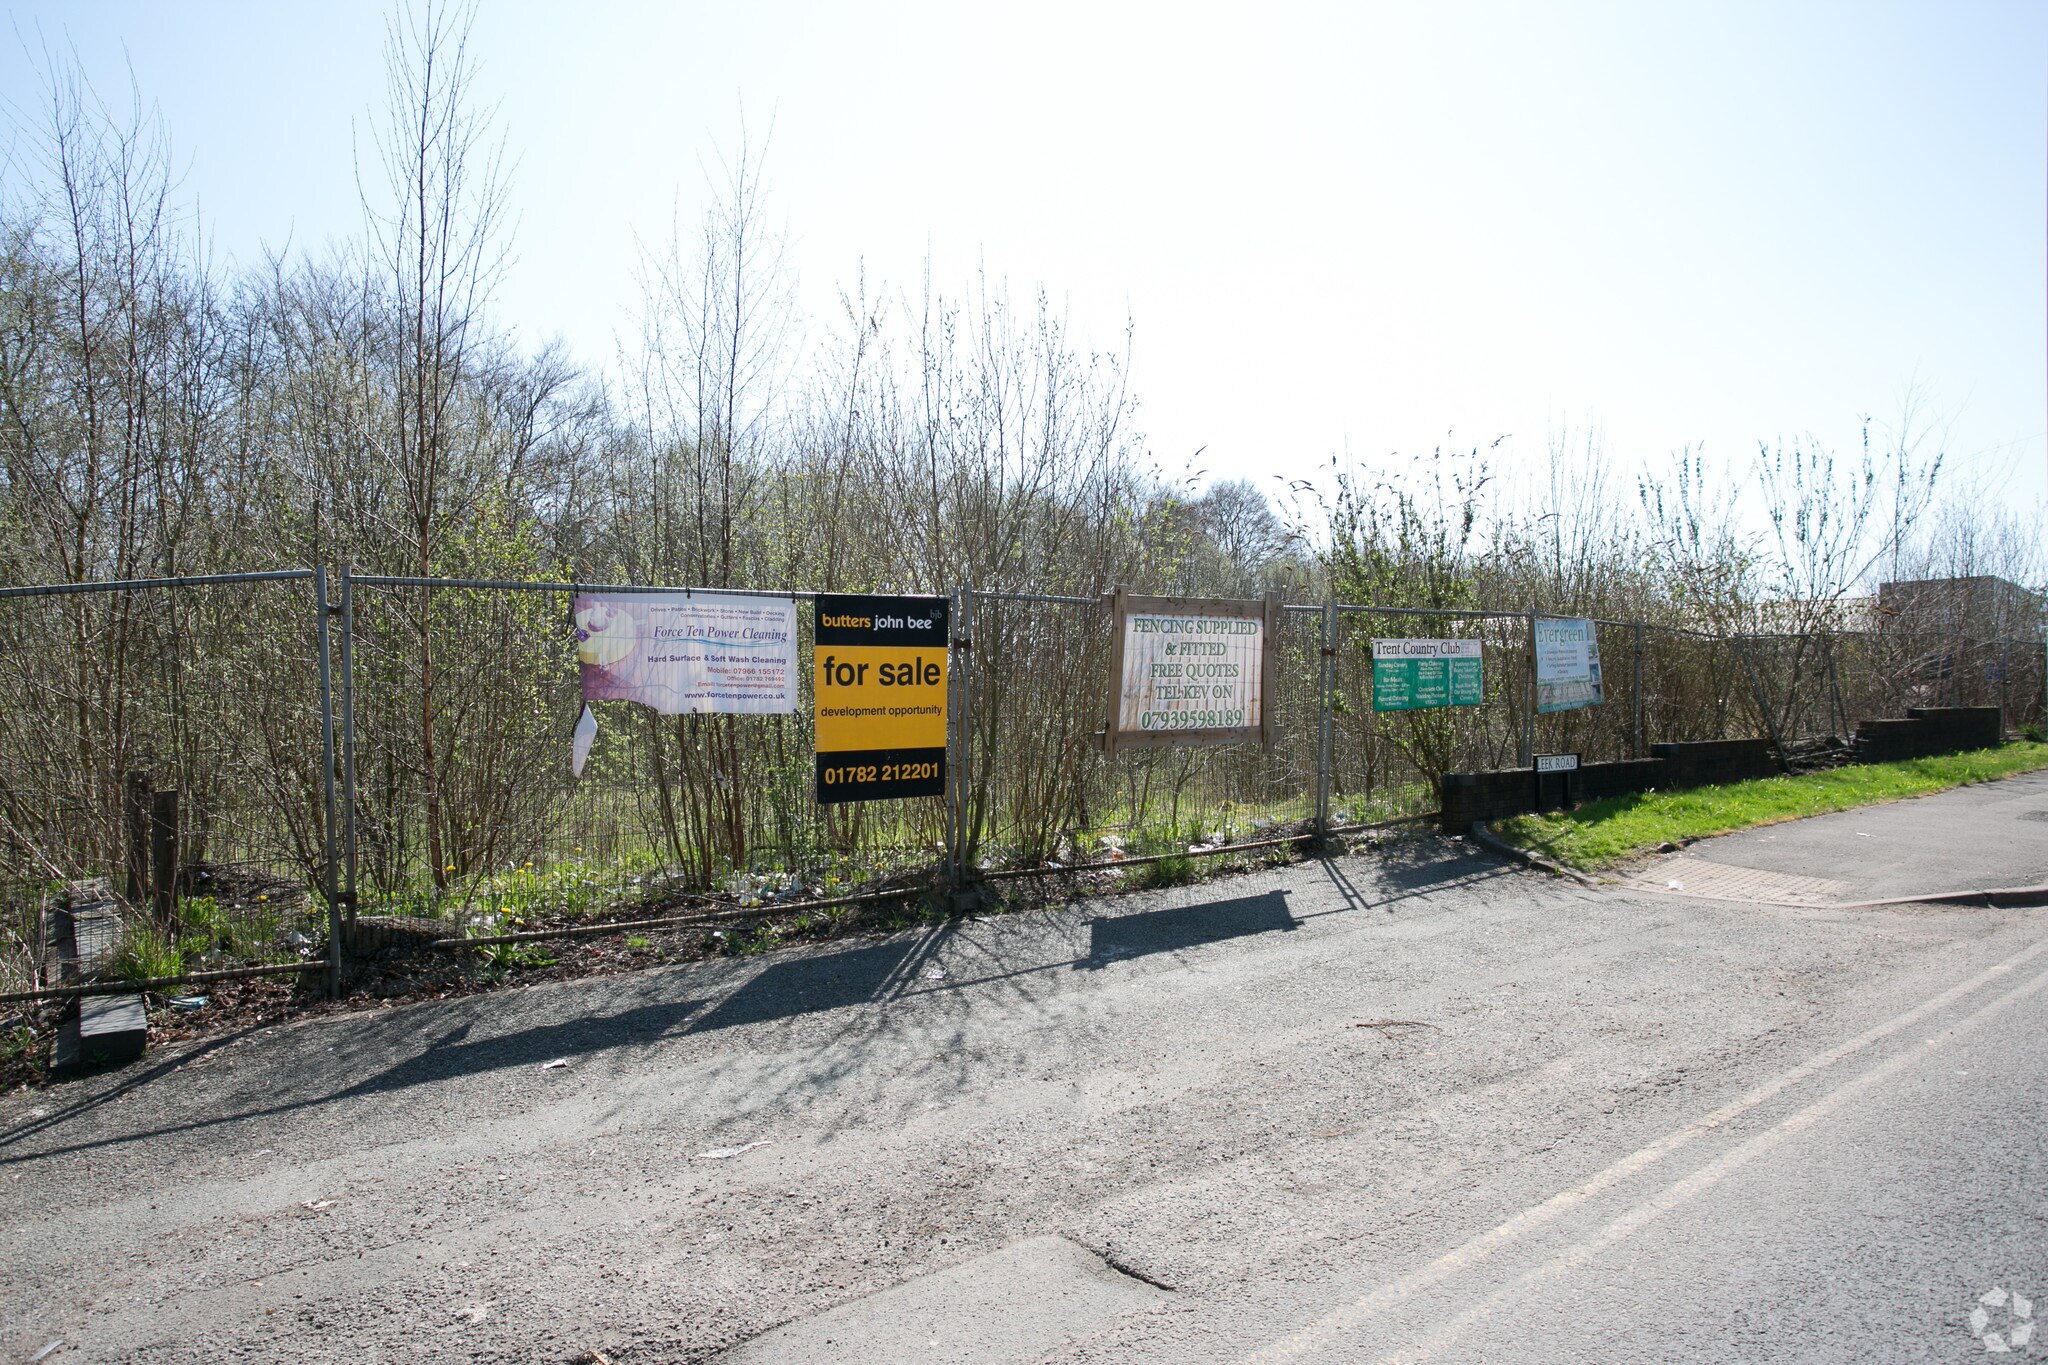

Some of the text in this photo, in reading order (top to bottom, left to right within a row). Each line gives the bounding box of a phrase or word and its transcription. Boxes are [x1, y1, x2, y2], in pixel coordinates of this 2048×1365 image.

[822, 613, 932, 631] butters john bee
[930, 609, 943, 621] bjb
[654, 625, 787, 643] Force Ten Power Cleaning
[1133, 618, 1259, 635] FENCING SUPPLIED
[1537, 622, 1584, 646] Evergreen
[1165, 642, 1227, 656] & FITTED
[1376, 641, 1400, 655] Trent
[1403, 641, 1438, 657] Country
[1440, 641, 1460, 654] Club
[669, 654, 701, 662] Surface
[751, 656, 787, 665] Cleaning
[707, 666, 731, 674] Mobile:
[823, 656, 941, 686] for sale
[1150, 663, 1239, 681] FREE QUOTES
[684, 690, 786, 700] www.forcetenpower.co.uk
[1155, 685, 1233, 700] TEL KEV ON
[821, 705, 942, 718] development opportunity
[1141, 710, 1243, 729] 07939598189
[1556, 757, 1576, 769] ROAD
[825, 762, 939, 785] 01782 212201
